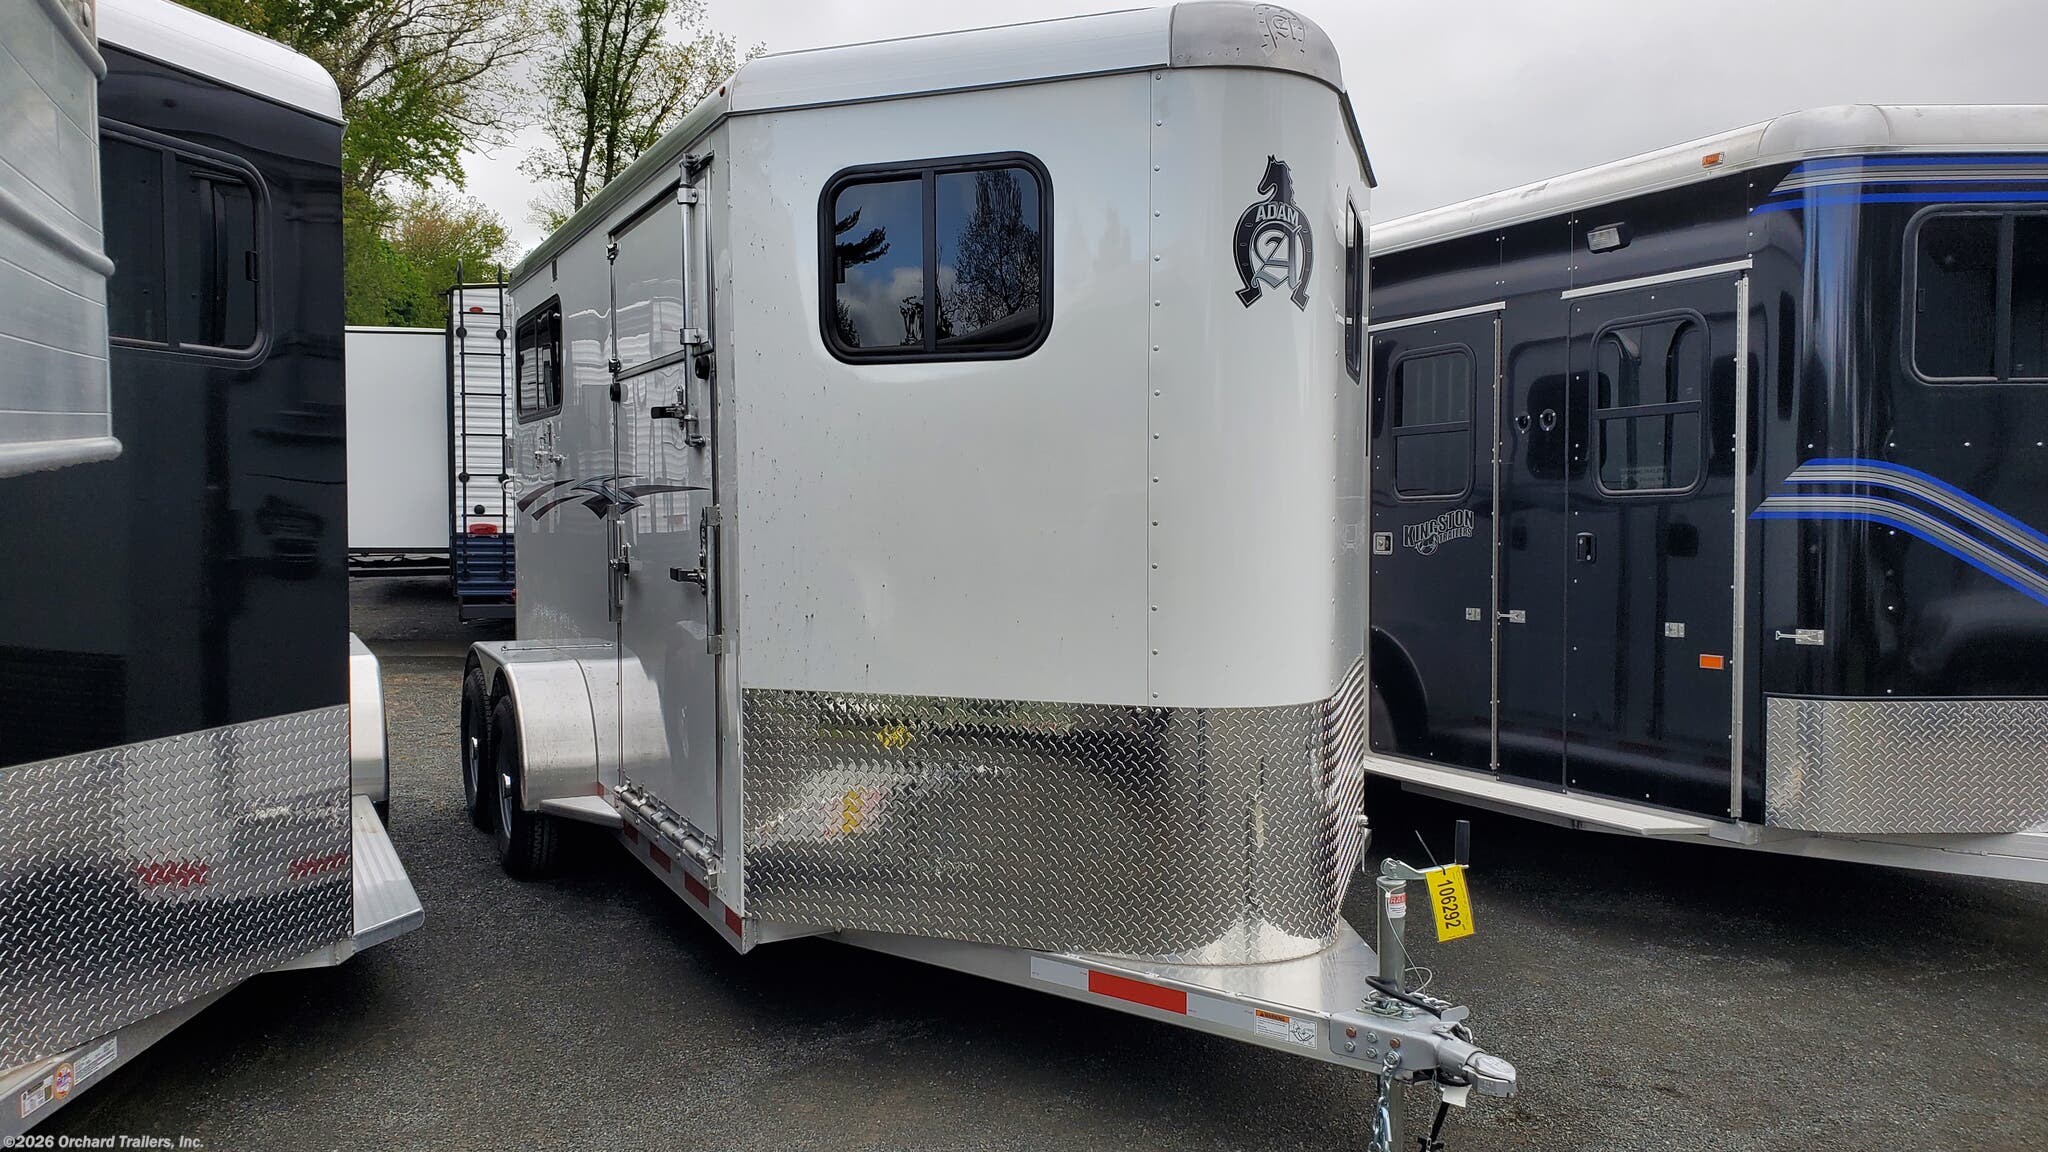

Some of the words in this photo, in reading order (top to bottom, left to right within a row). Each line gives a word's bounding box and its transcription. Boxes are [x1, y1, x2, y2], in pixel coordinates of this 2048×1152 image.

[1255, 202, 1300, 226] ADAM
[1402, 509, 1475, 548] KINGSTON
[1438, 528, 1473, 544] TRAILERS
[1437, 879, 1461, 929] 106292
